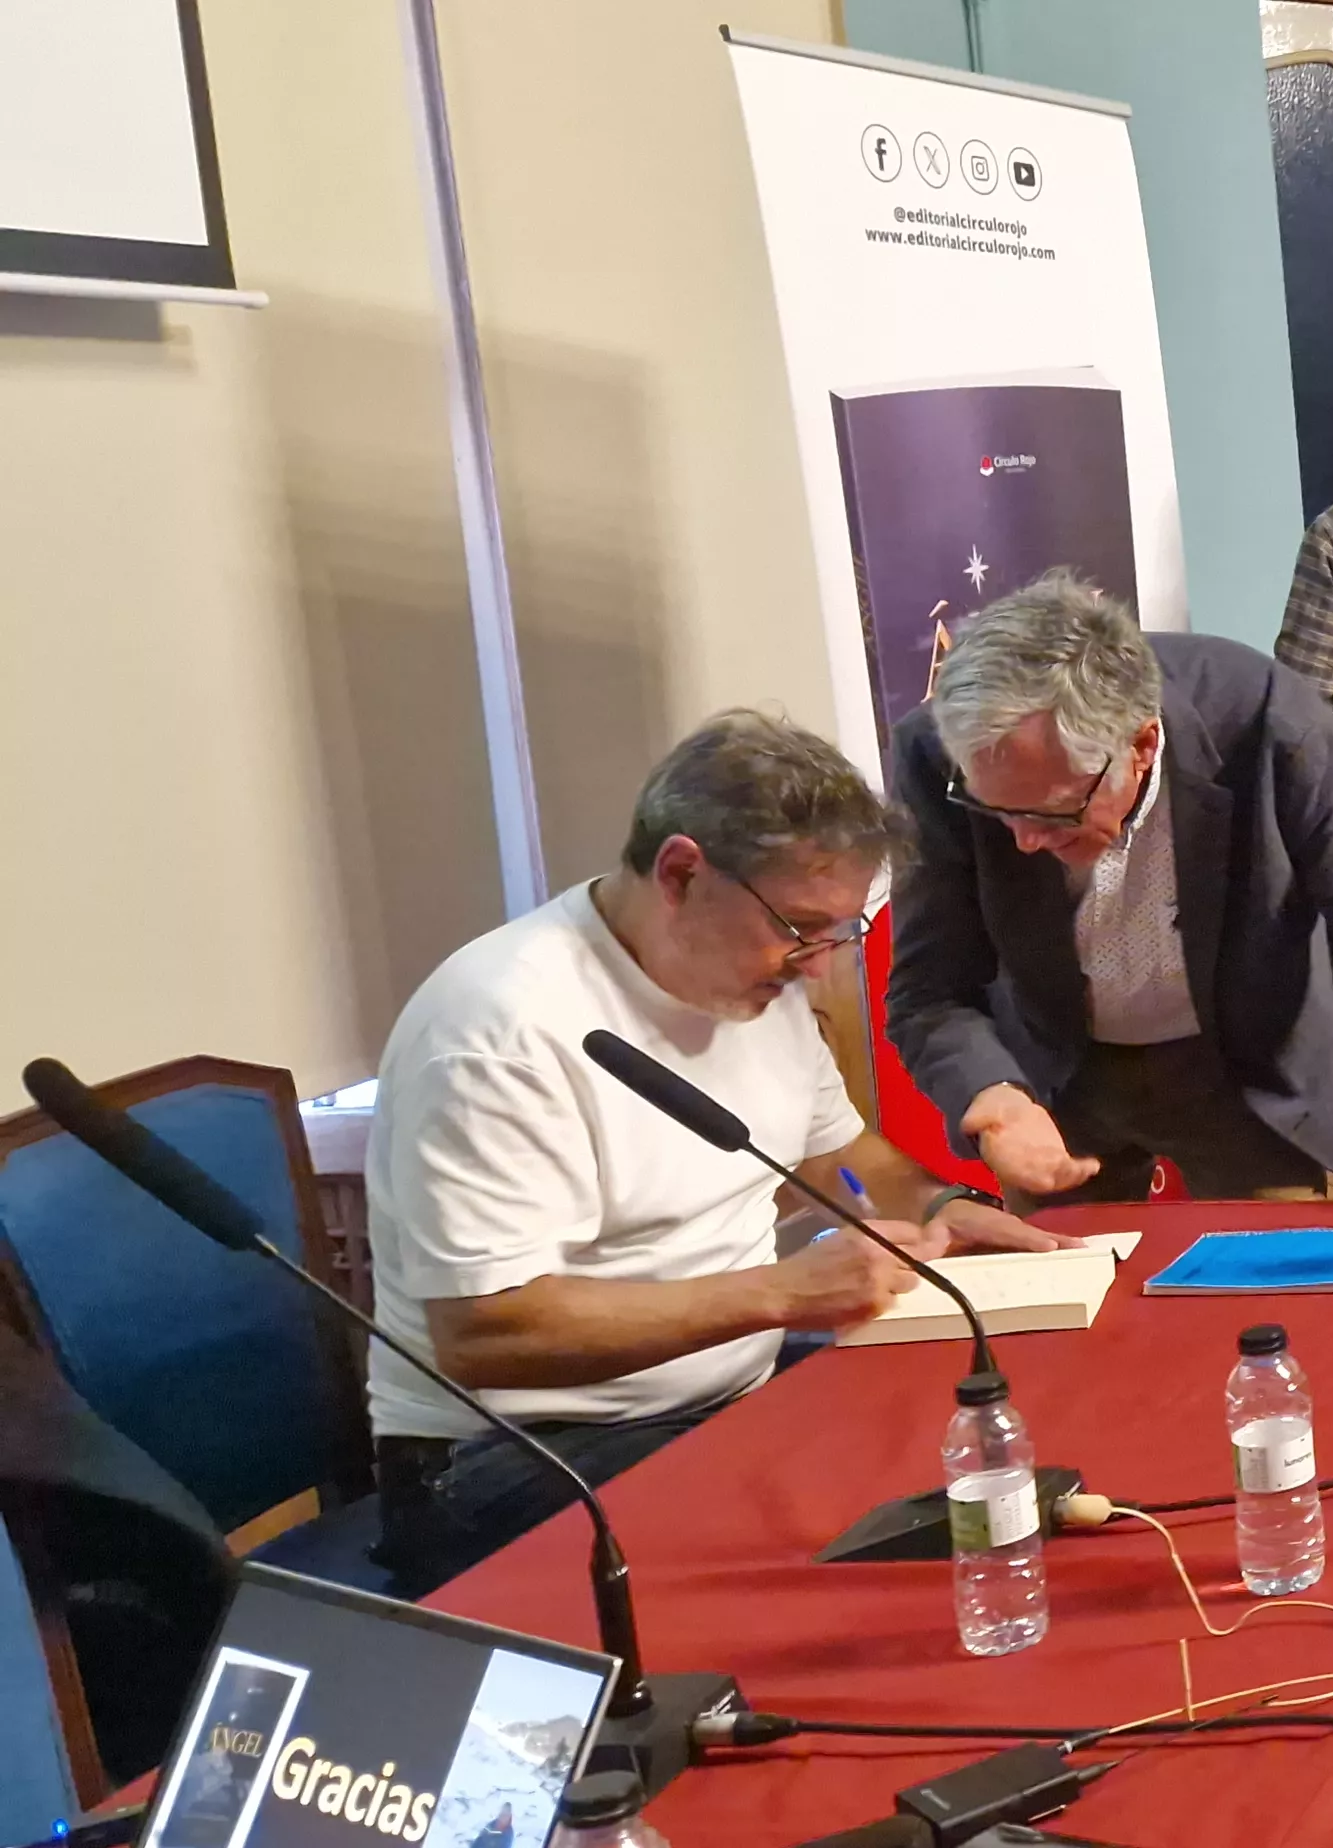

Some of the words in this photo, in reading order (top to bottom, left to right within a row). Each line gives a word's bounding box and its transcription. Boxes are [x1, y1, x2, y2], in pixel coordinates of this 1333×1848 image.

[893, 206, 1028, 239] @editorialcirculorojo
[865, 228, 1056, 261] www.editorialcirculorojo.com
[272, 1736, 436, 1842] Gracias
